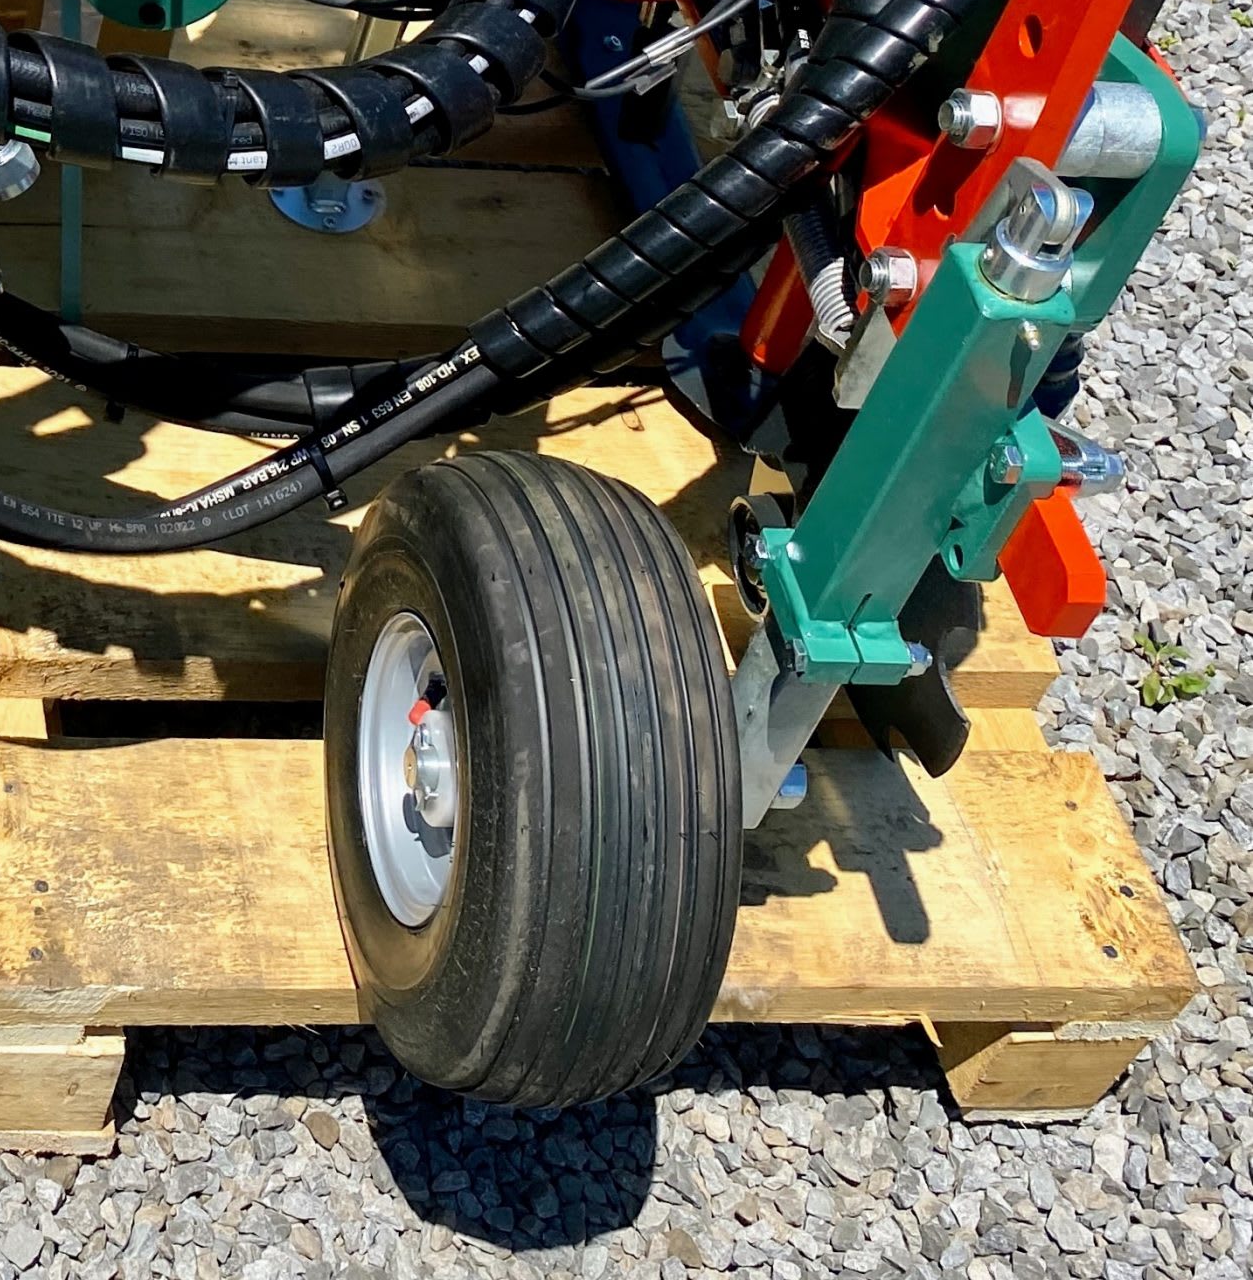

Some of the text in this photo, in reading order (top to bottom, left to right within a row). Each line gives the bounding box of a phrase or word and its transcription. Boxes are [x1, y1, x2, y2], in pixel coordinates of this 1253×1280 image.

[436, 360, 458, 380] HD
[415, 372, 438, 393] 108
[392, 389, 413, 408] EN
[371, 400, 394, 419] 853
[341, 420, 361, 438] SN
[360, 415, 370, 427] 1
[320, 433, 337, 449] 08
[290, 448, 311, 467] WP
[198, 484, 235, 510] MSHA
[20, 503, 41, 519] 854
[222, 503, 251, 521] (LOT
